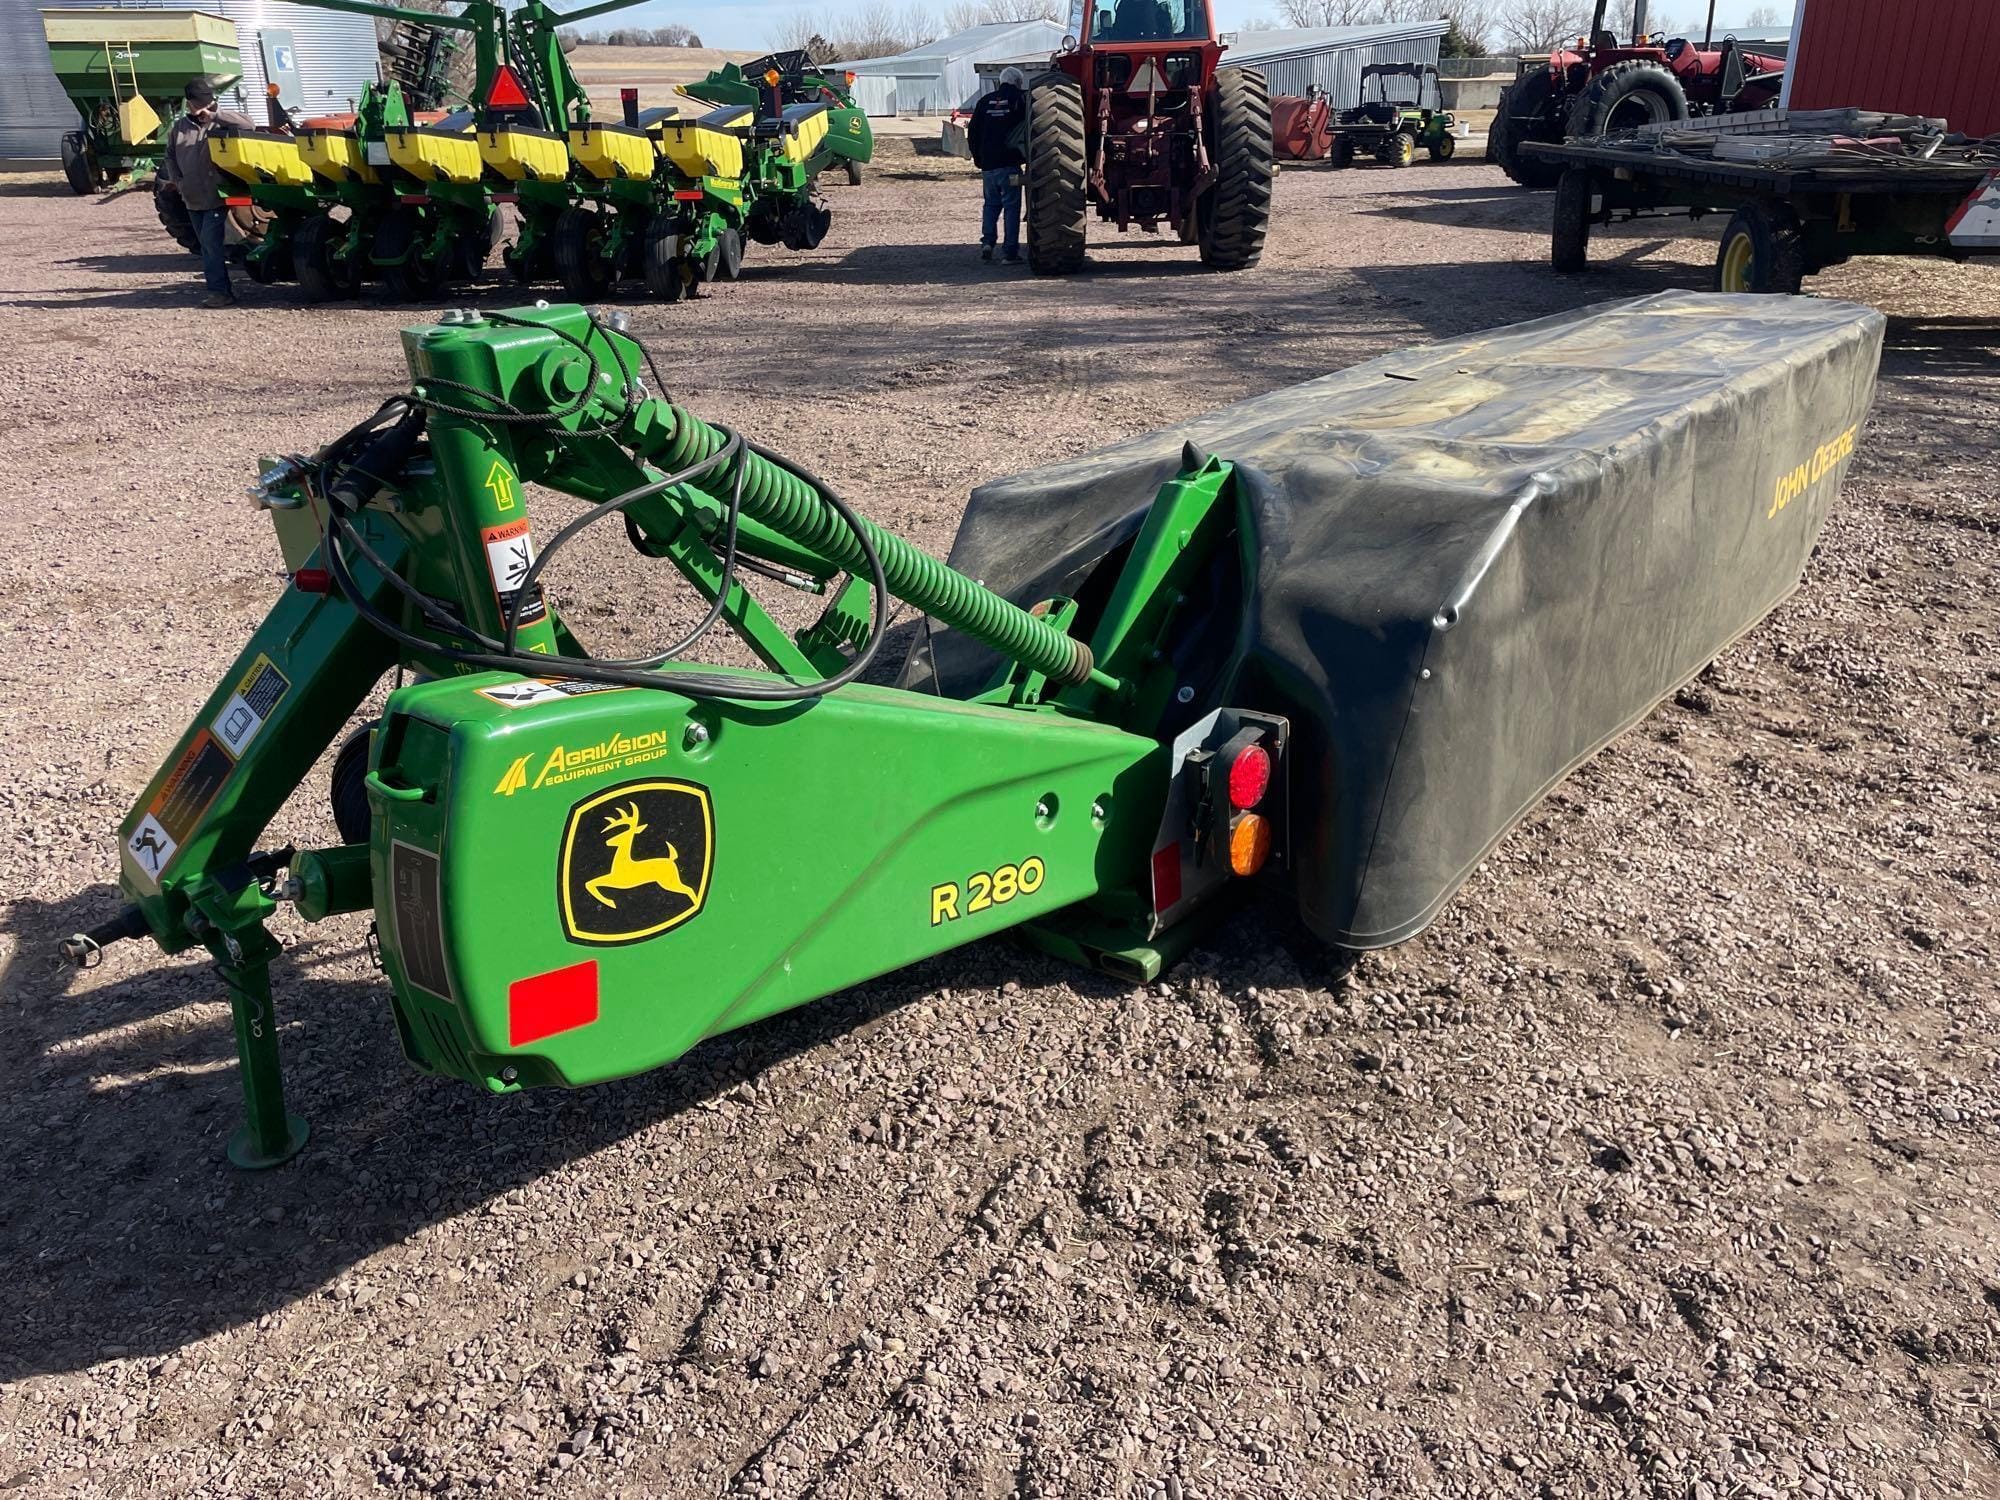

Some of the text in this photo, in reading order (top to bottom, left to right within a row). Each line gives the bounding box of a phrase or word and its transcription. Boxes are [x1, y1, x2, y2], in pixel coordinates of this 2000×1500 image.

[1767, 423, 1857, 520] JOHN DEERE
[244, 661, 264, 688] CAUTION
[545, 748, 667, 787] EQUIPMENT GROUP
[931, 855, 1045, 927] R 280
